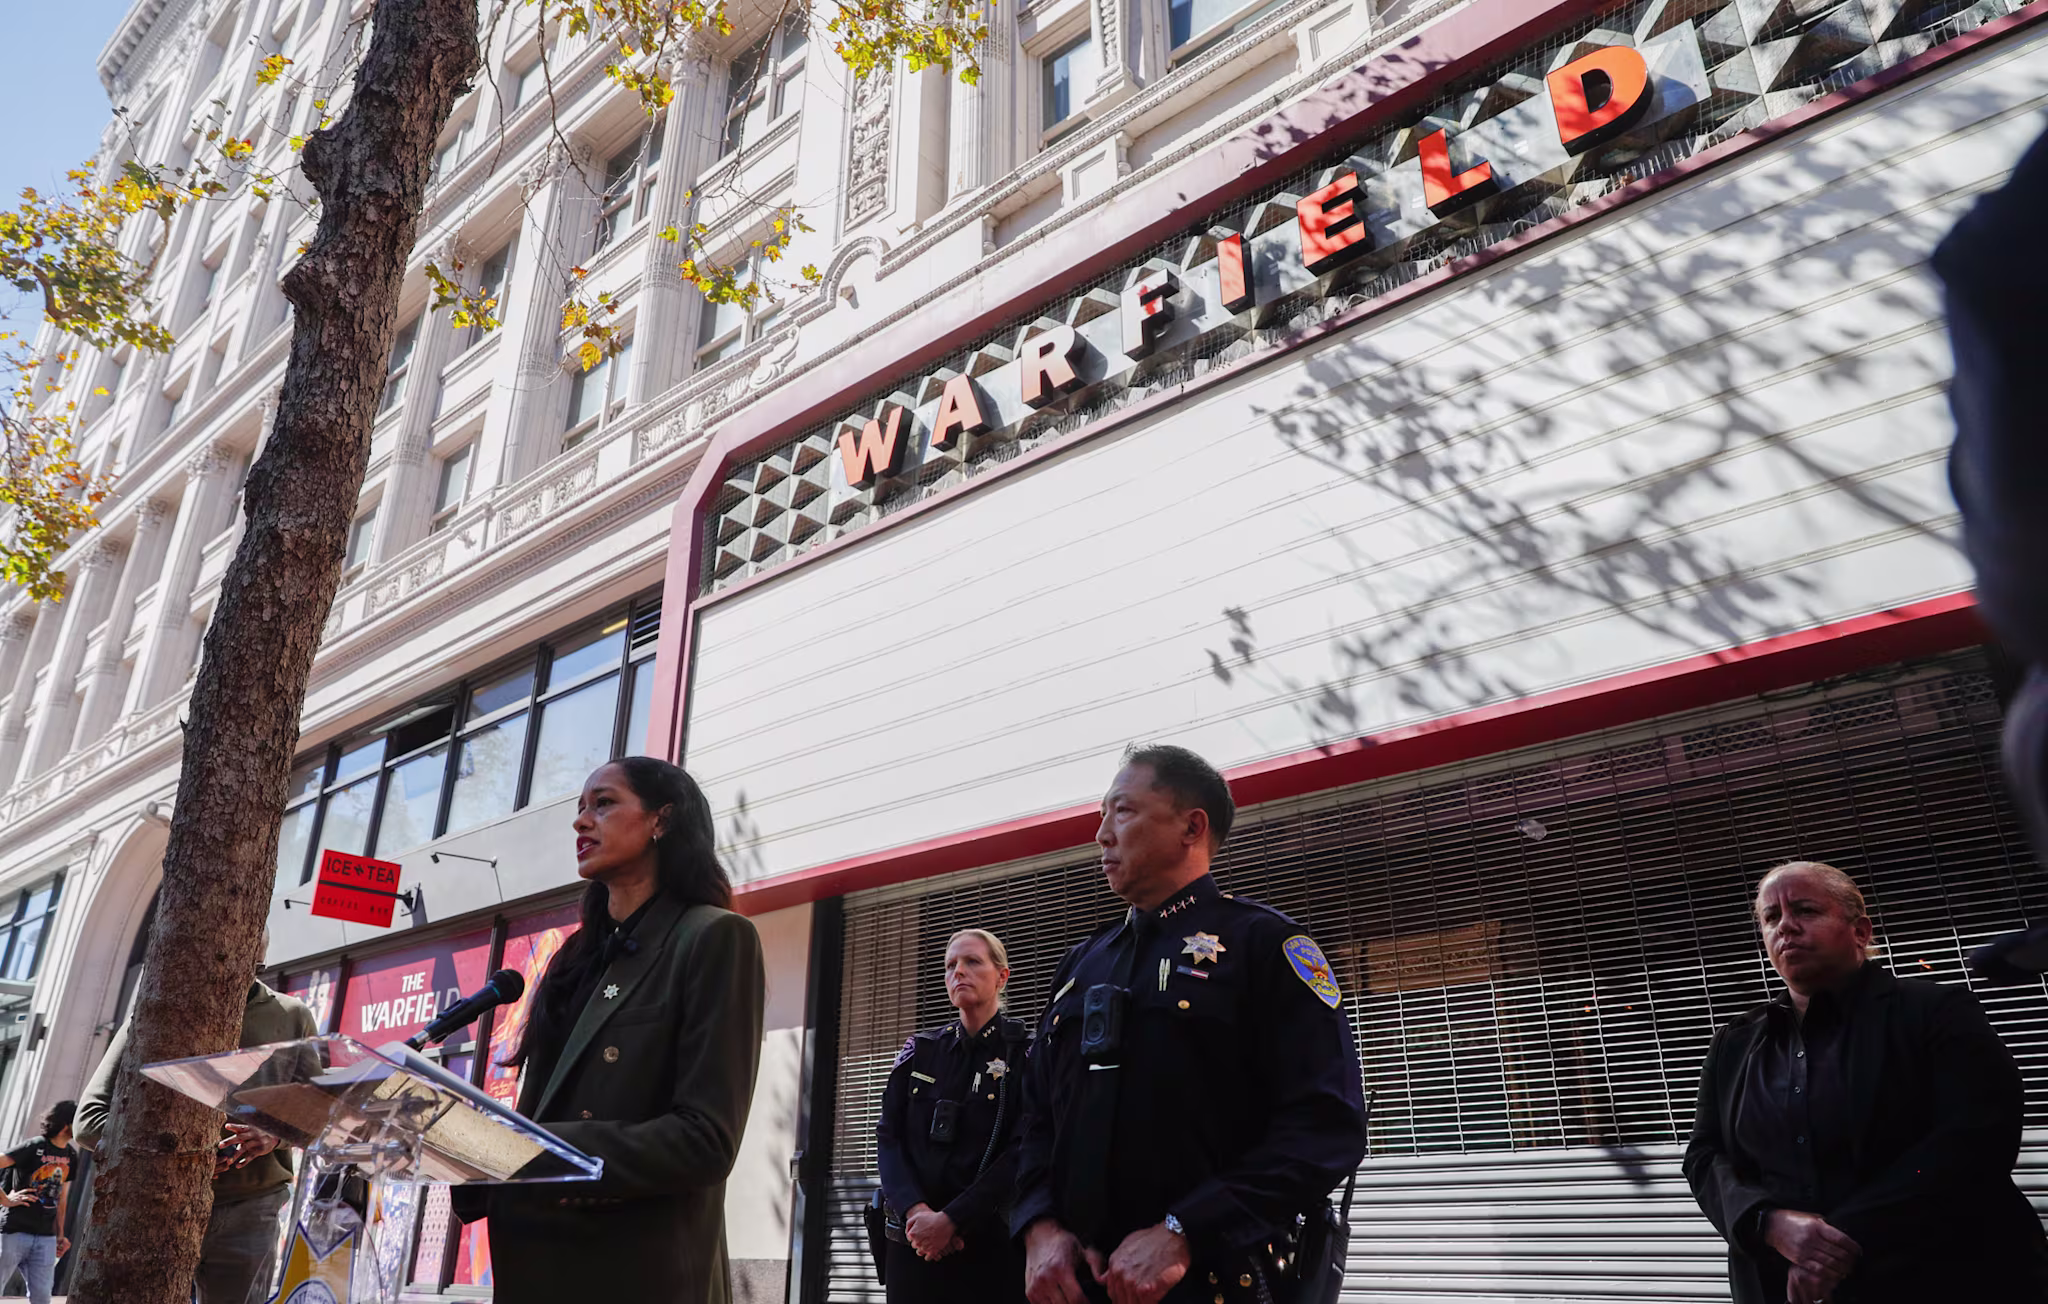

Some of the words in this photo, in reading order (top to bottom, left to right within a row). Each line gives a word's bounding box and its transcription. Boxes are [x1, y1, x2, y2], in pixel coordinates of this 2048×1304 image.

[838, 45, 1649, 487] WARFIELD
[326, 856, 353, 876] ICE
[367, 865, 395, 884] TEA
[402, 972, 426, 993] THE
